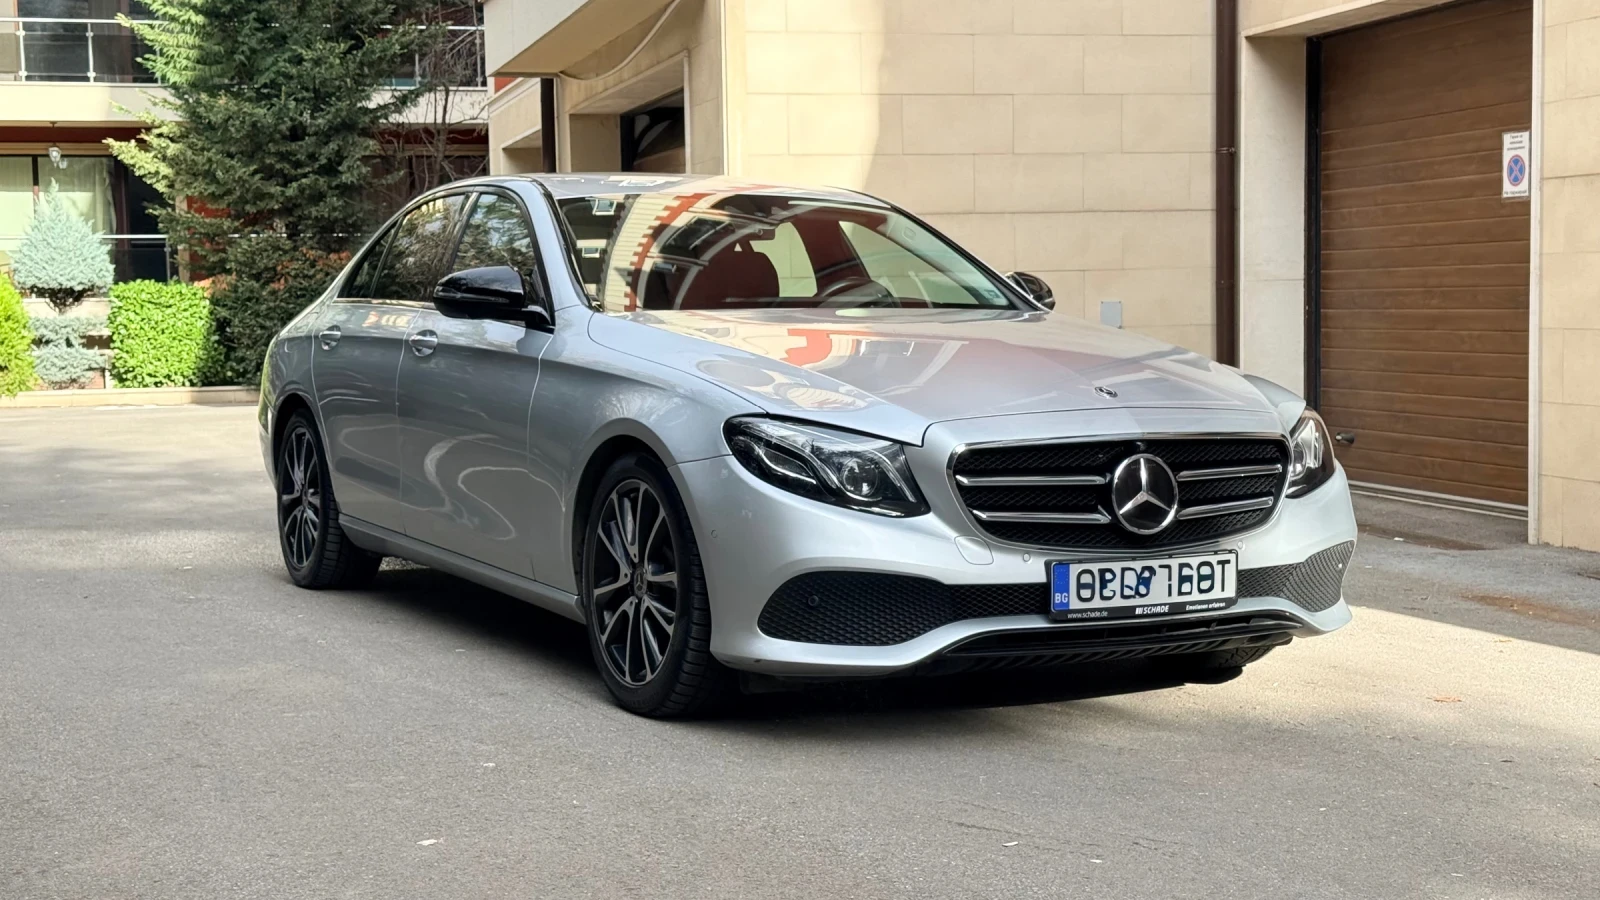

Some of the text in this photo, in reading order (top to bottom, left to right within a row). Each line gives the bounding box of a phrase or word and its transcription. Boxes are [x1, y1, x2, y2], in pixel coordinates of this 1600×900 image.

[1055, 593, 1069, 603] BG
[1143, 605, 1170, 614] SCHADE
[1067, 610, 1108, 619] www.schade.de
